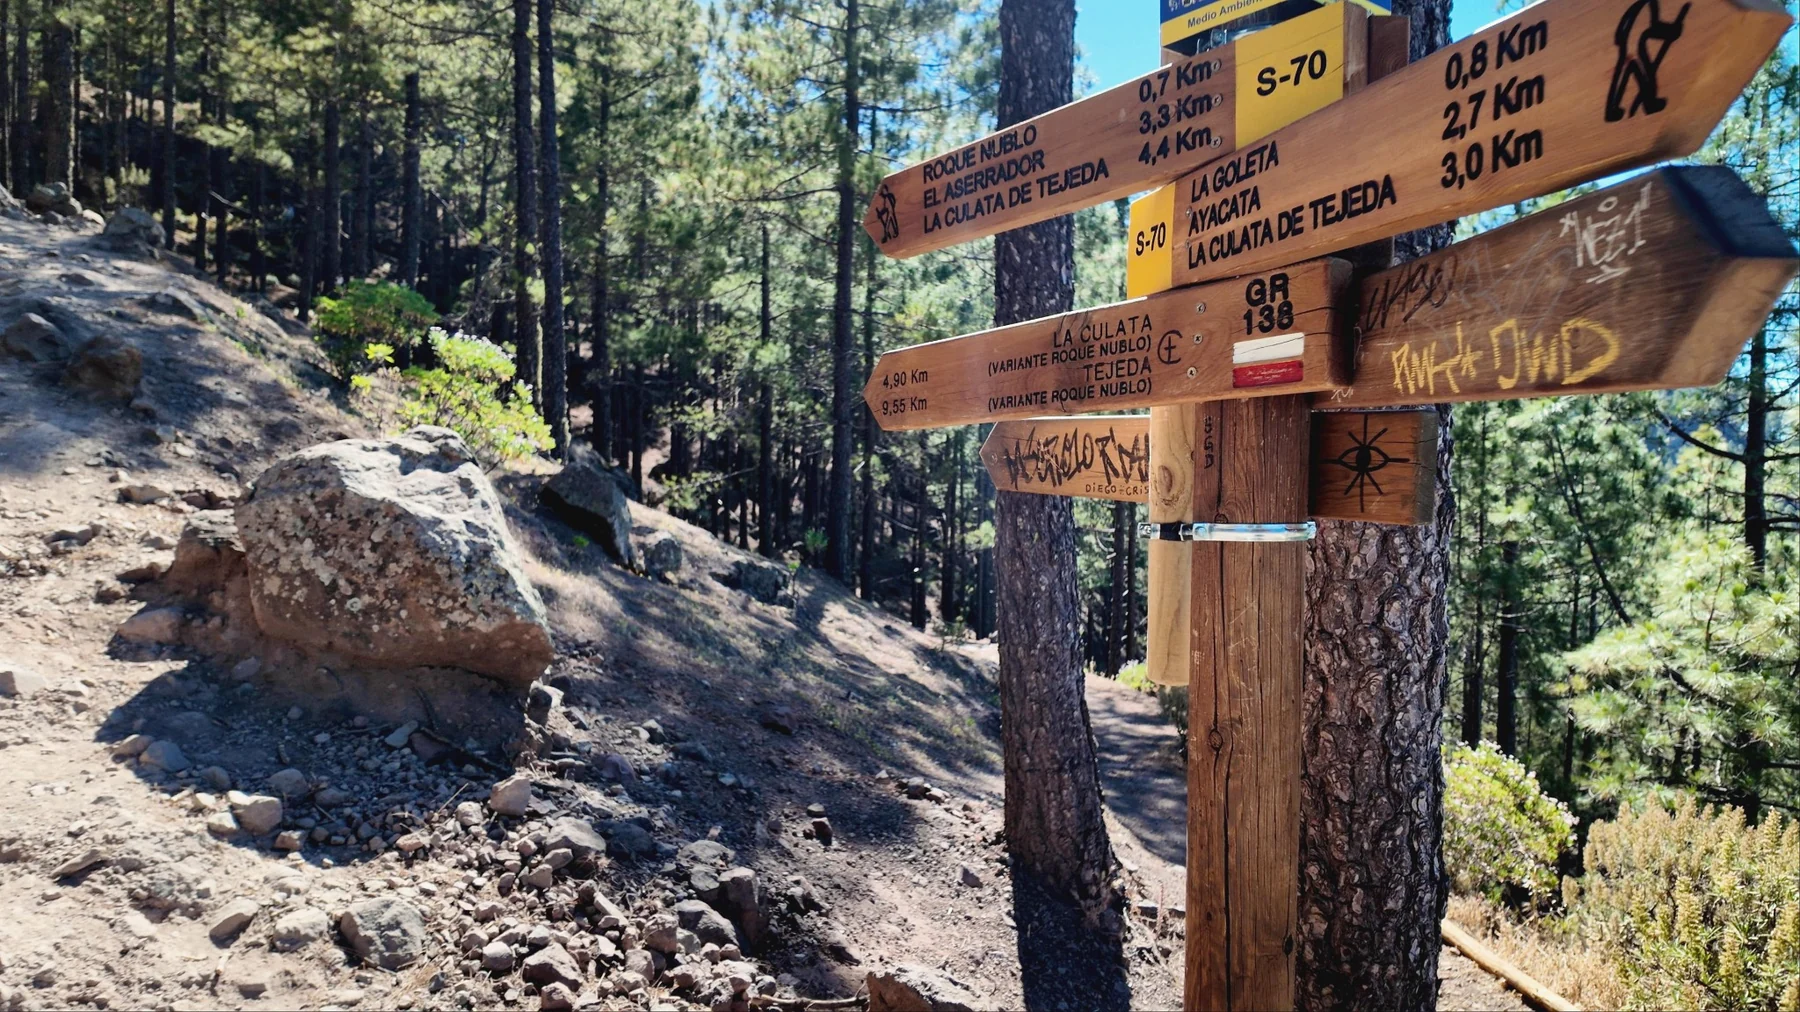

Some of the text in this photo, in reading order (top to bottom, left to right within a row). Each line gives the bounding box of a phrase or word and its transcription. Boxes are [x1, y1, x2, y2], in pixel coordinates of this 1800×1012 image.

[1187, 11, 1217, 28] Medio
[1256, 49, 1327, 97] S-70
[923, 61, 1212, 184] ROQUE NUBLO 0,7 Km
[1191, 19, 1548, 203] LA GOLETA 0,8 Km
[924, 93, 1212, 209] EL ASERRADOR 3,3 Km
[1188, 73, 1545, 237] AYACATA 2,7 Km
[924, 125, 1212, 234] LA CULATA DE TEJEDA 4,4 Km
[1188, 128, 1543, 270] LA CULATA DE TEJEDA 3,0 Km
[1135, 221, 1166, 256] S-70
[1245, 272, 1290, 307] GR
[1053, 313, 1152, 349] LA CULATA
[1243, 300, 1294, 335] 138
[988, 334, 1152, 377] (VARIANTE ROQUE NUBLO)
[1083, 356, 1152, 382] TEJEDA
[883, 368, 928, 390] 4,90 Km
[988, 377, 1152, 412] (VARIANTE ROQUE NUBLO)
[882, 396, 928, 416] 9,55 Km
